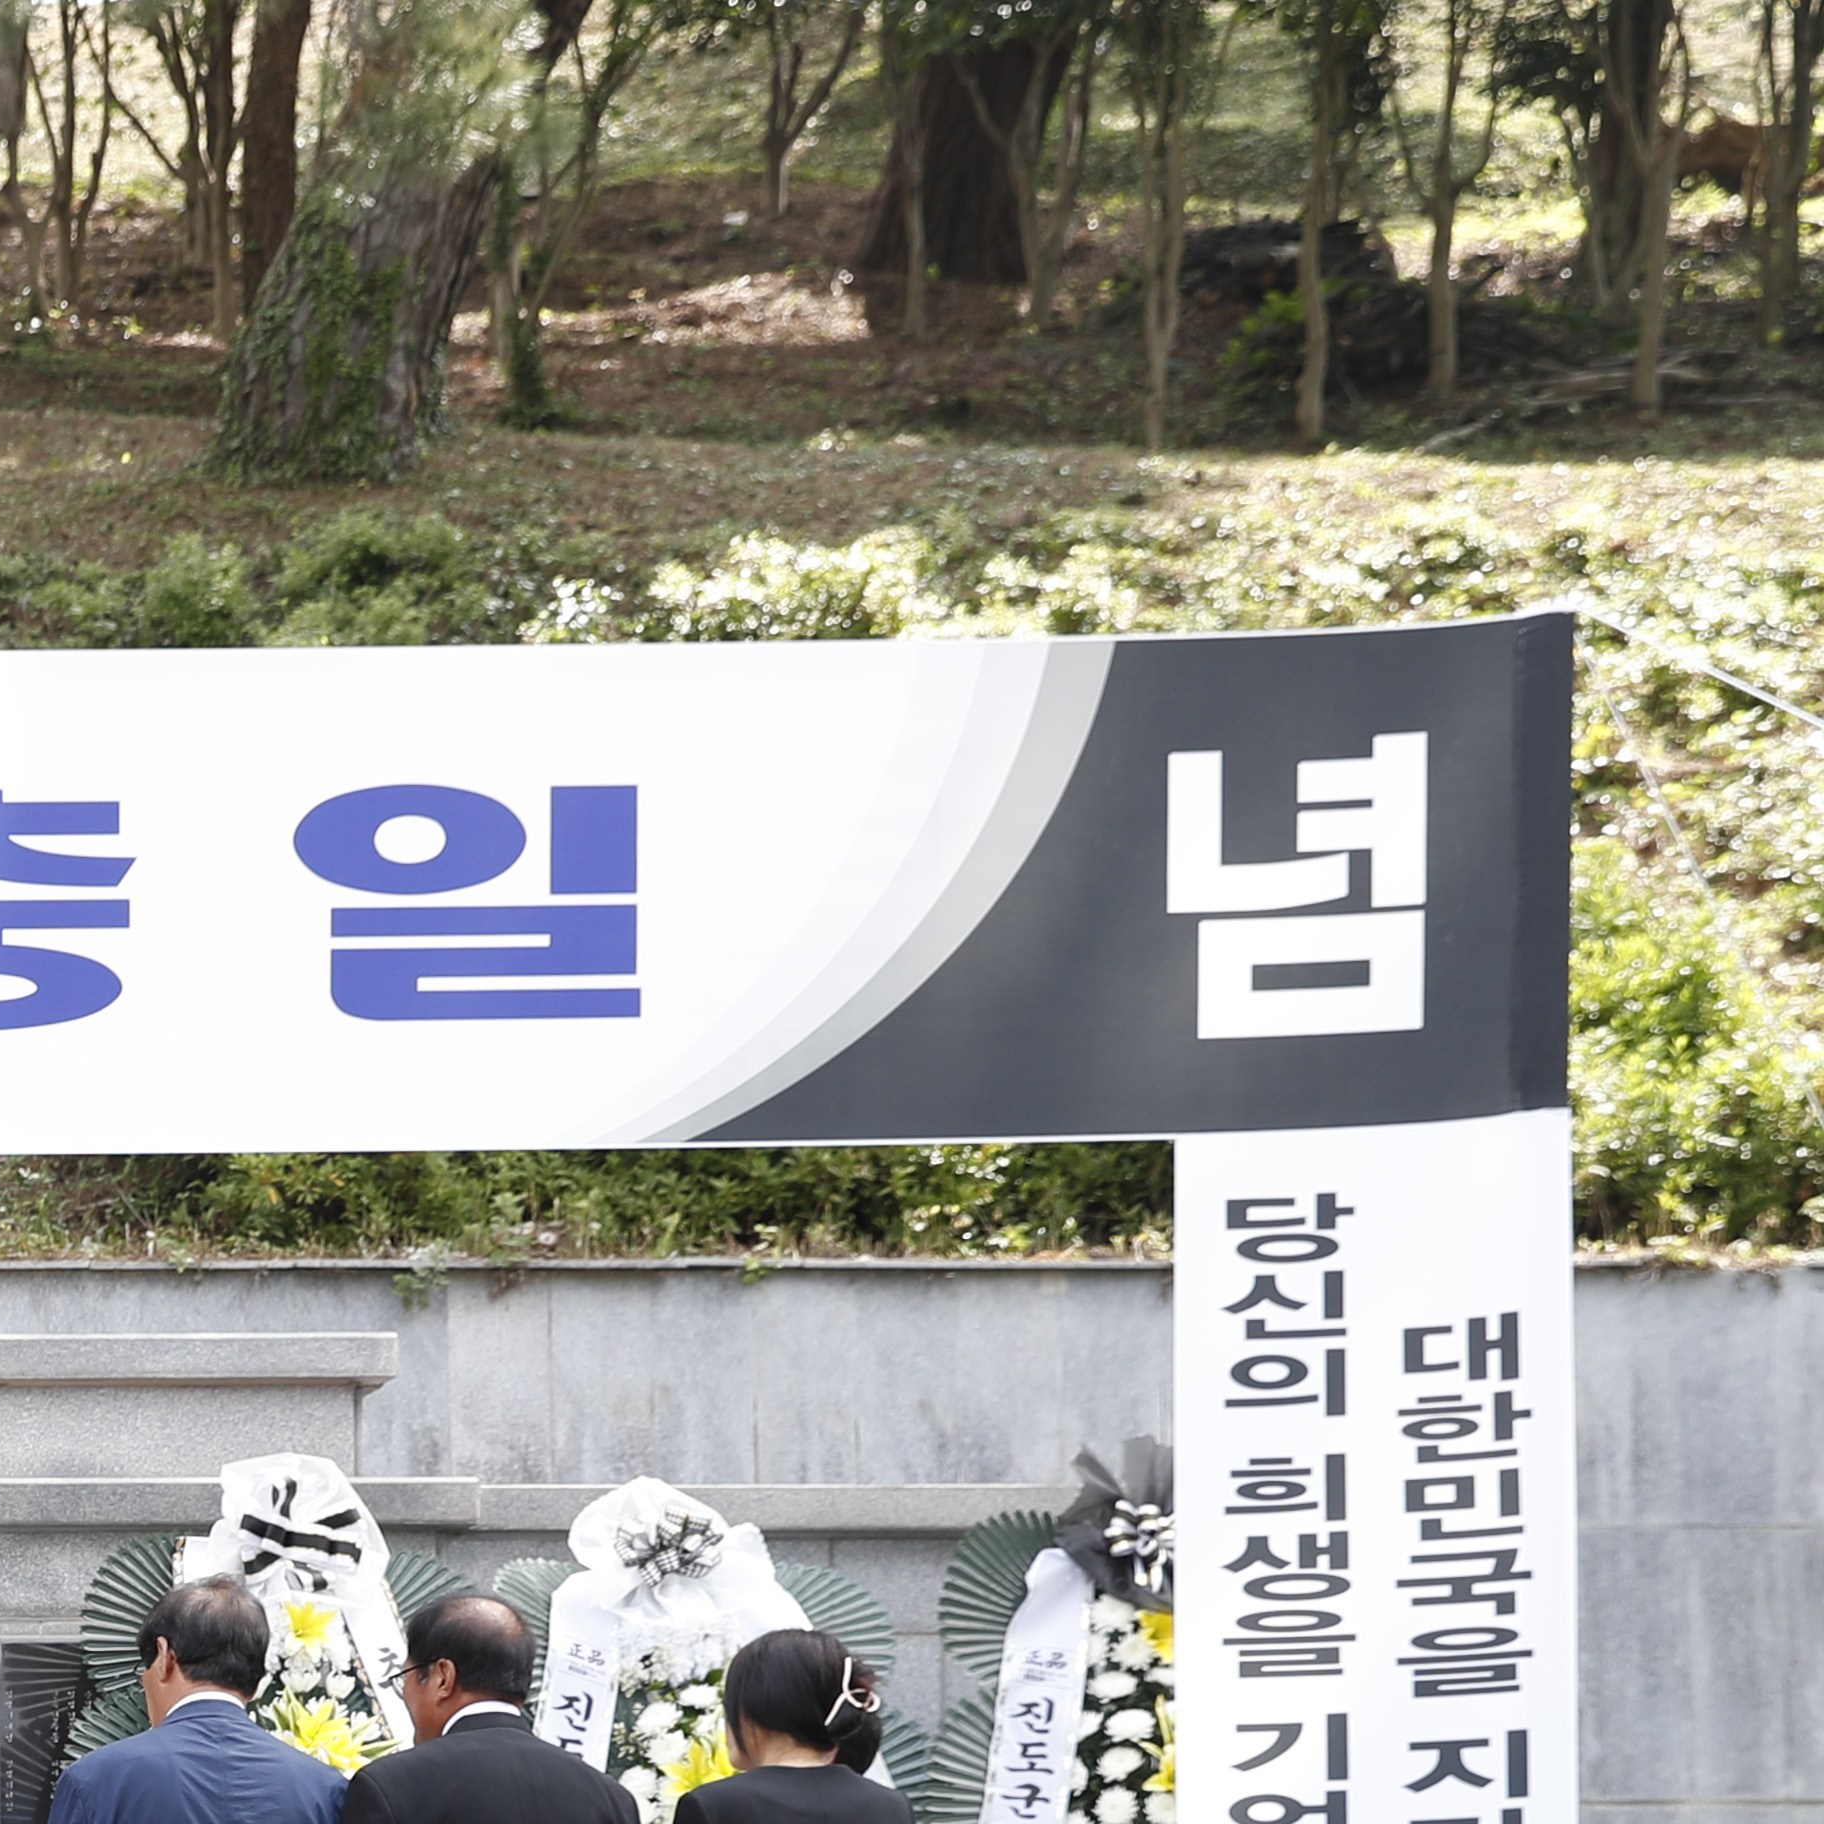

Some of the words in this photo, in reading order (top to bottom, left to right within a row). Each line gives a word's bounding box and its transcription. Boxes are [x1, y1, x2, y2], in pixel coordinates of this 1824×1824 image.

[1166, 731, 1428, 1040] 념
[1223, 1192, 1355, 1417] 당신의
[1223, 1453, 1357, 1678] 희생을
[1396, 1311, 1533, 1698] 대한민국을
